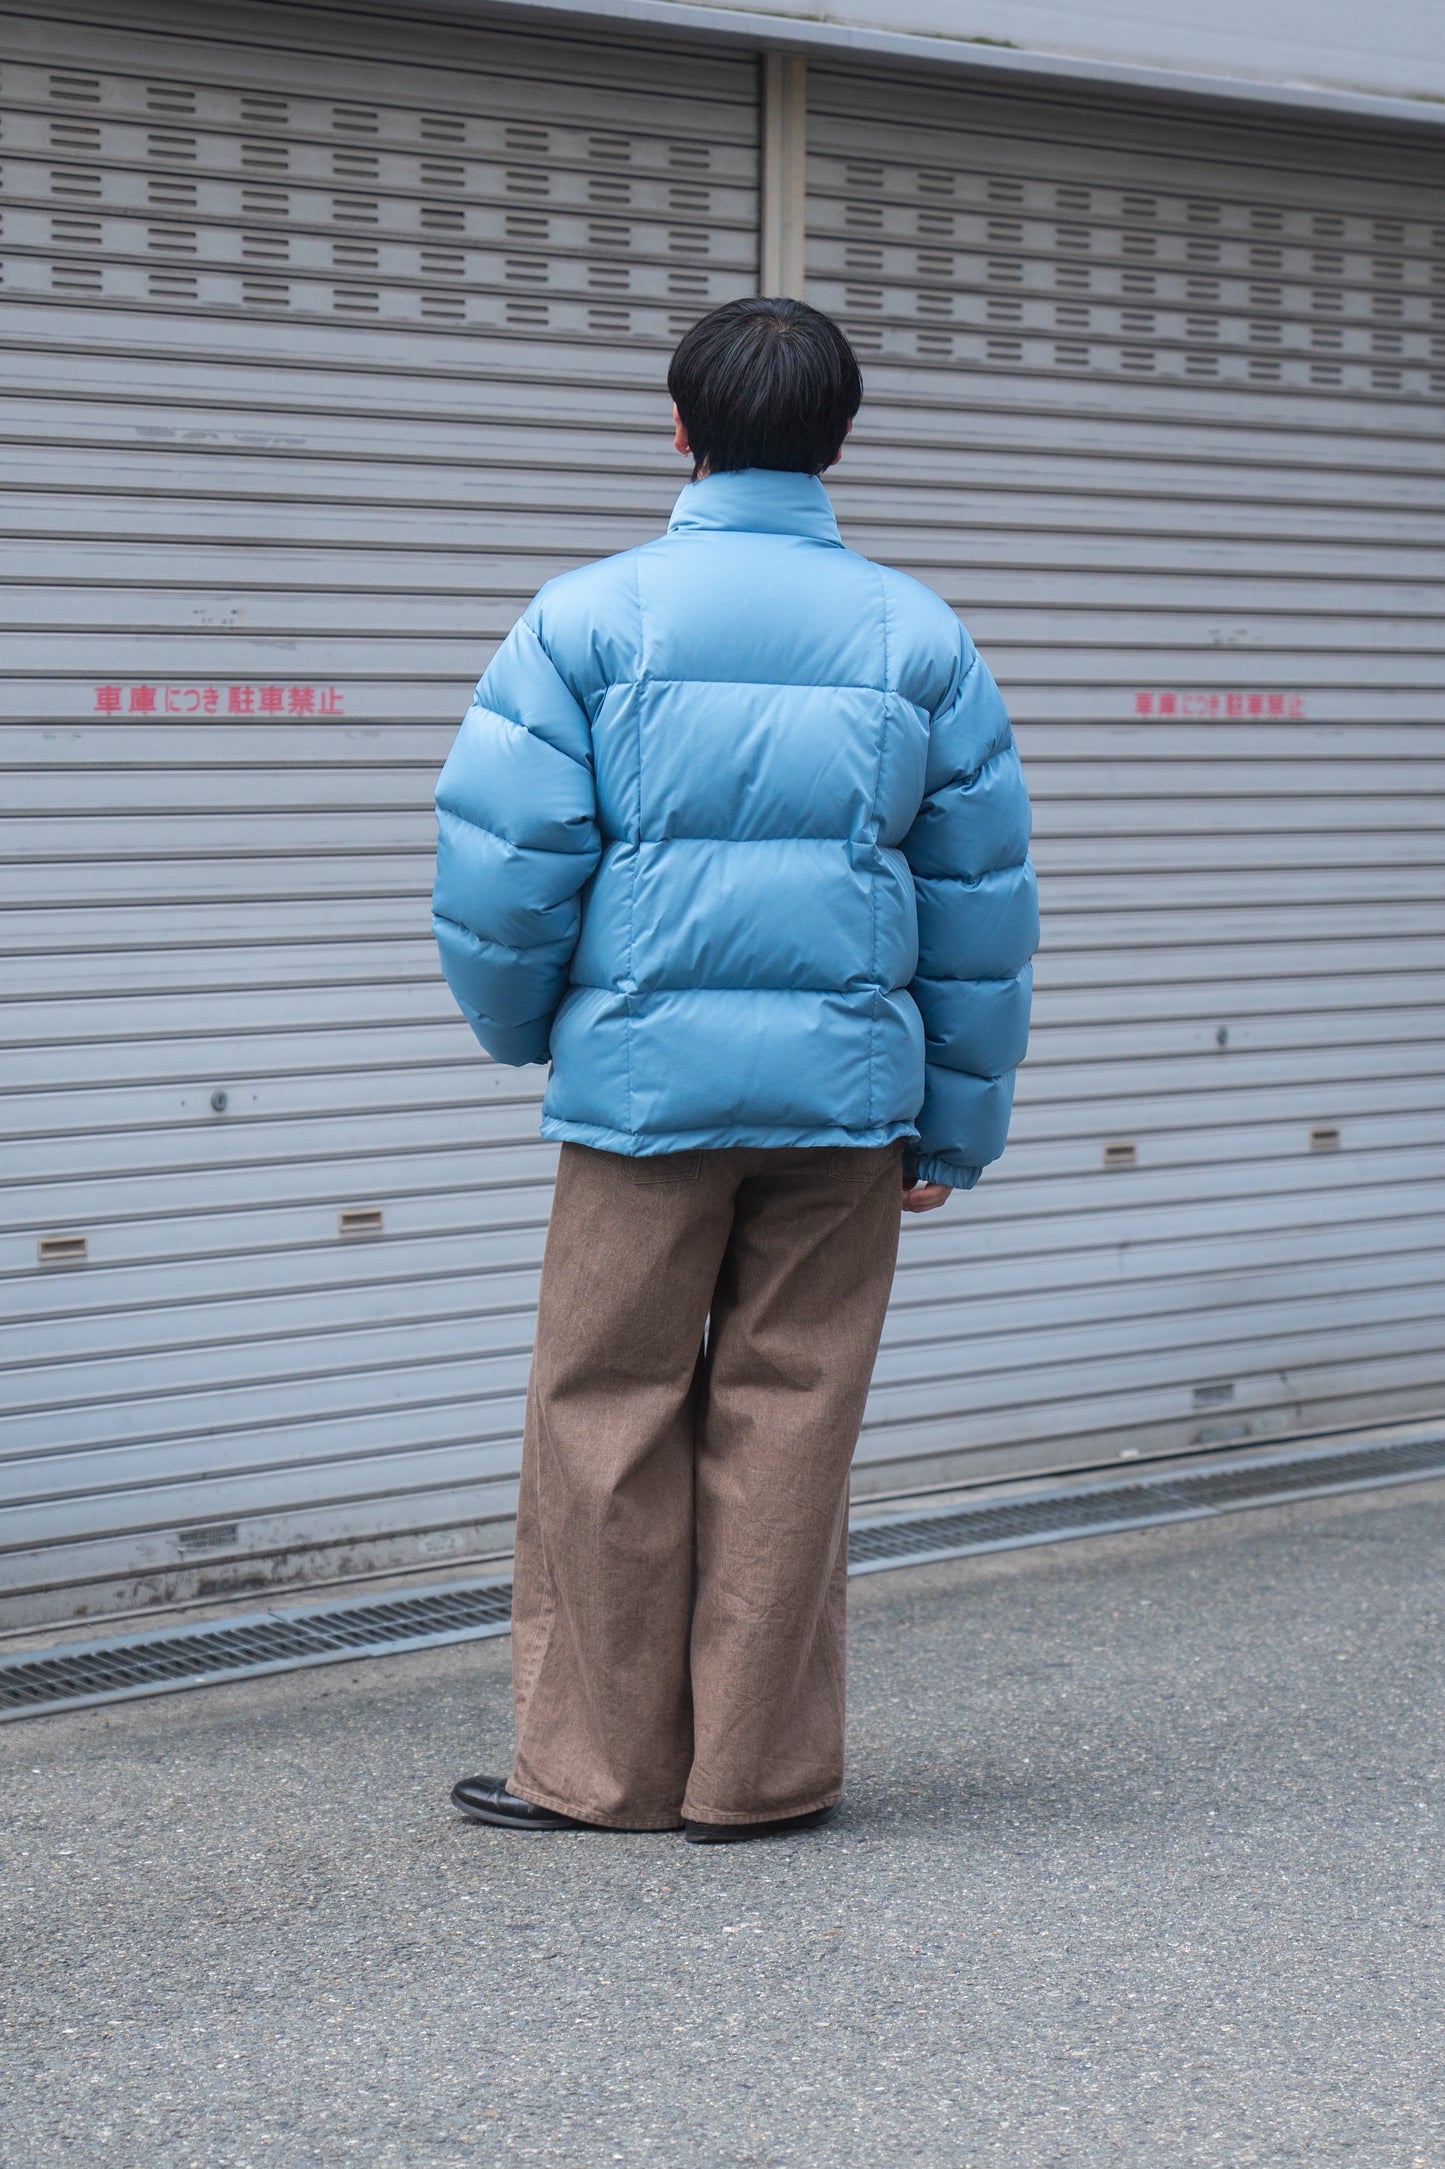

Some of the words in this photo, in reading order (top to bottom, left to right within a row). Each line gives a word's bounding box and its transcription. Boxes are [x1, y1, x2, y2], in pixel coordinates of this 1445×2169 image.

[94, 685, 344, 715] 車庫につき駐車禁止
